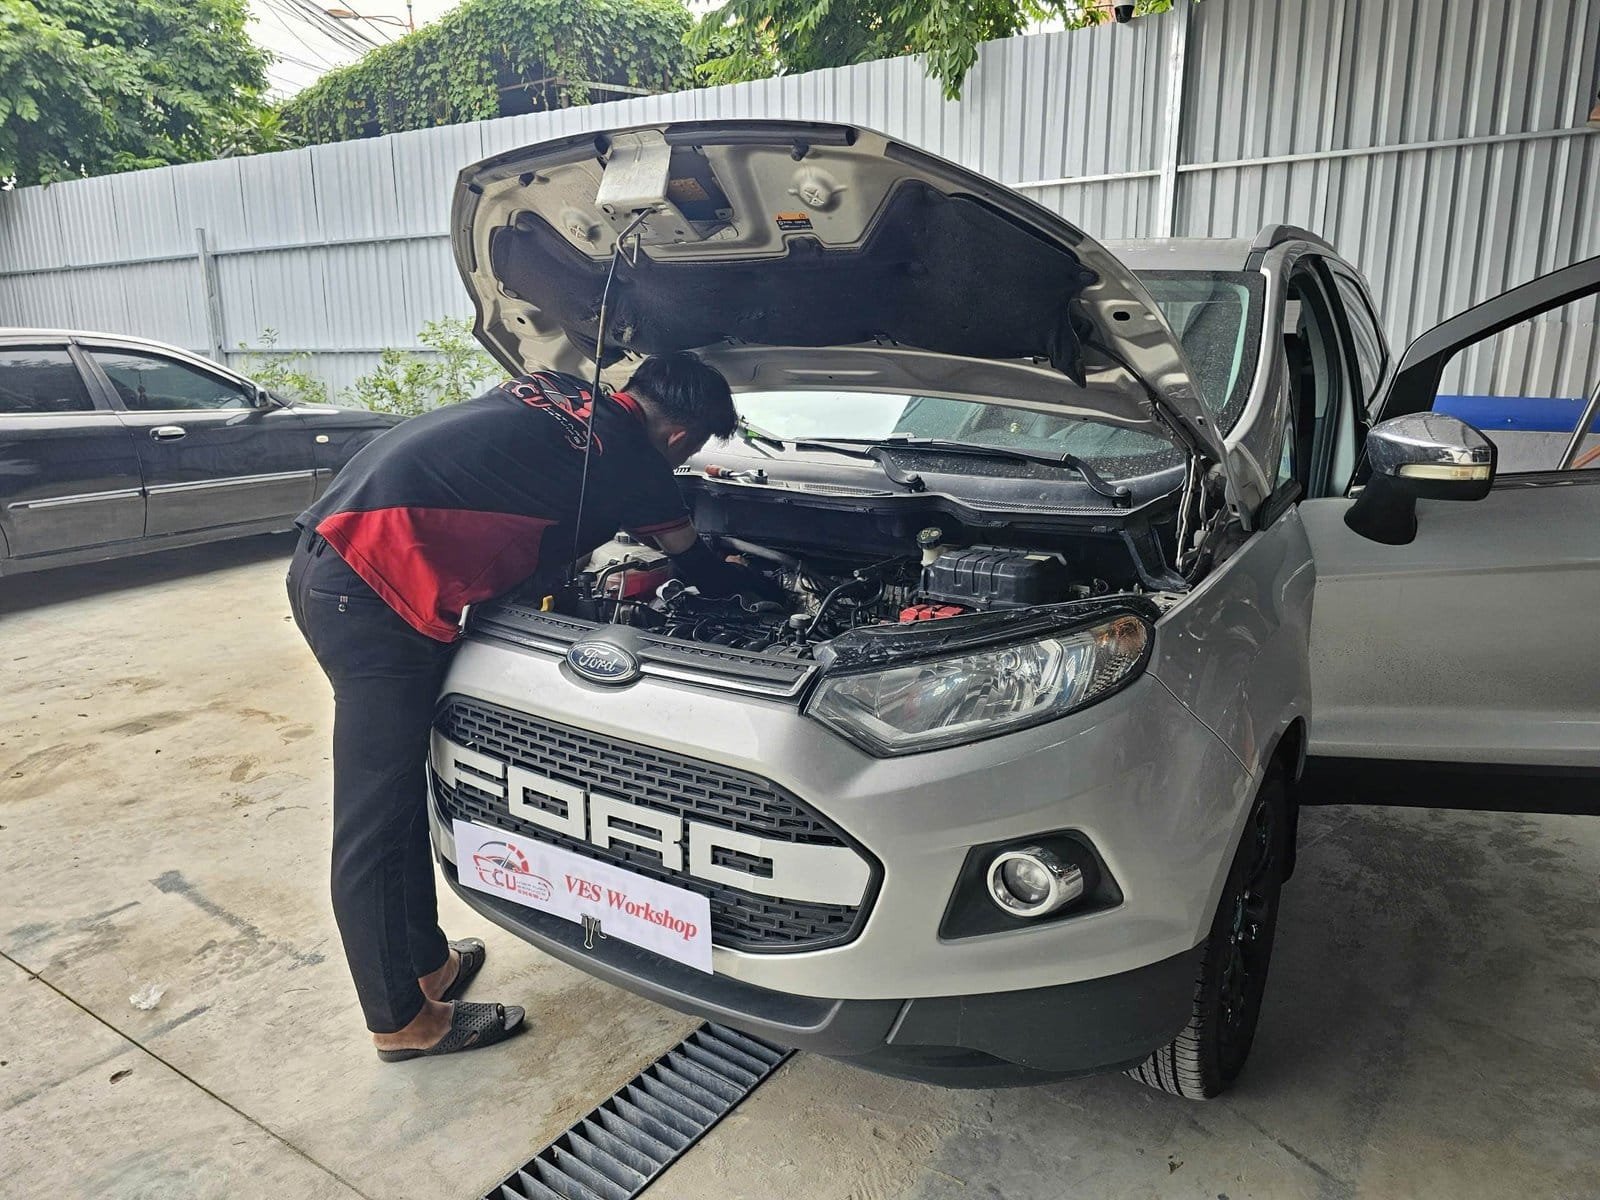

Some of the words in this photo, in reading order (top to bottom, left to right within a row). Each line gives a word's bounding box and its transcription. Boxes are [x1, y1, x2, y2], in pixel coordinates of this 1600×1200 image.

[579, 647, 618, 672] Ford
[564, 874, 602, 902] VES
[607, 888, 698, 941] Workshop
